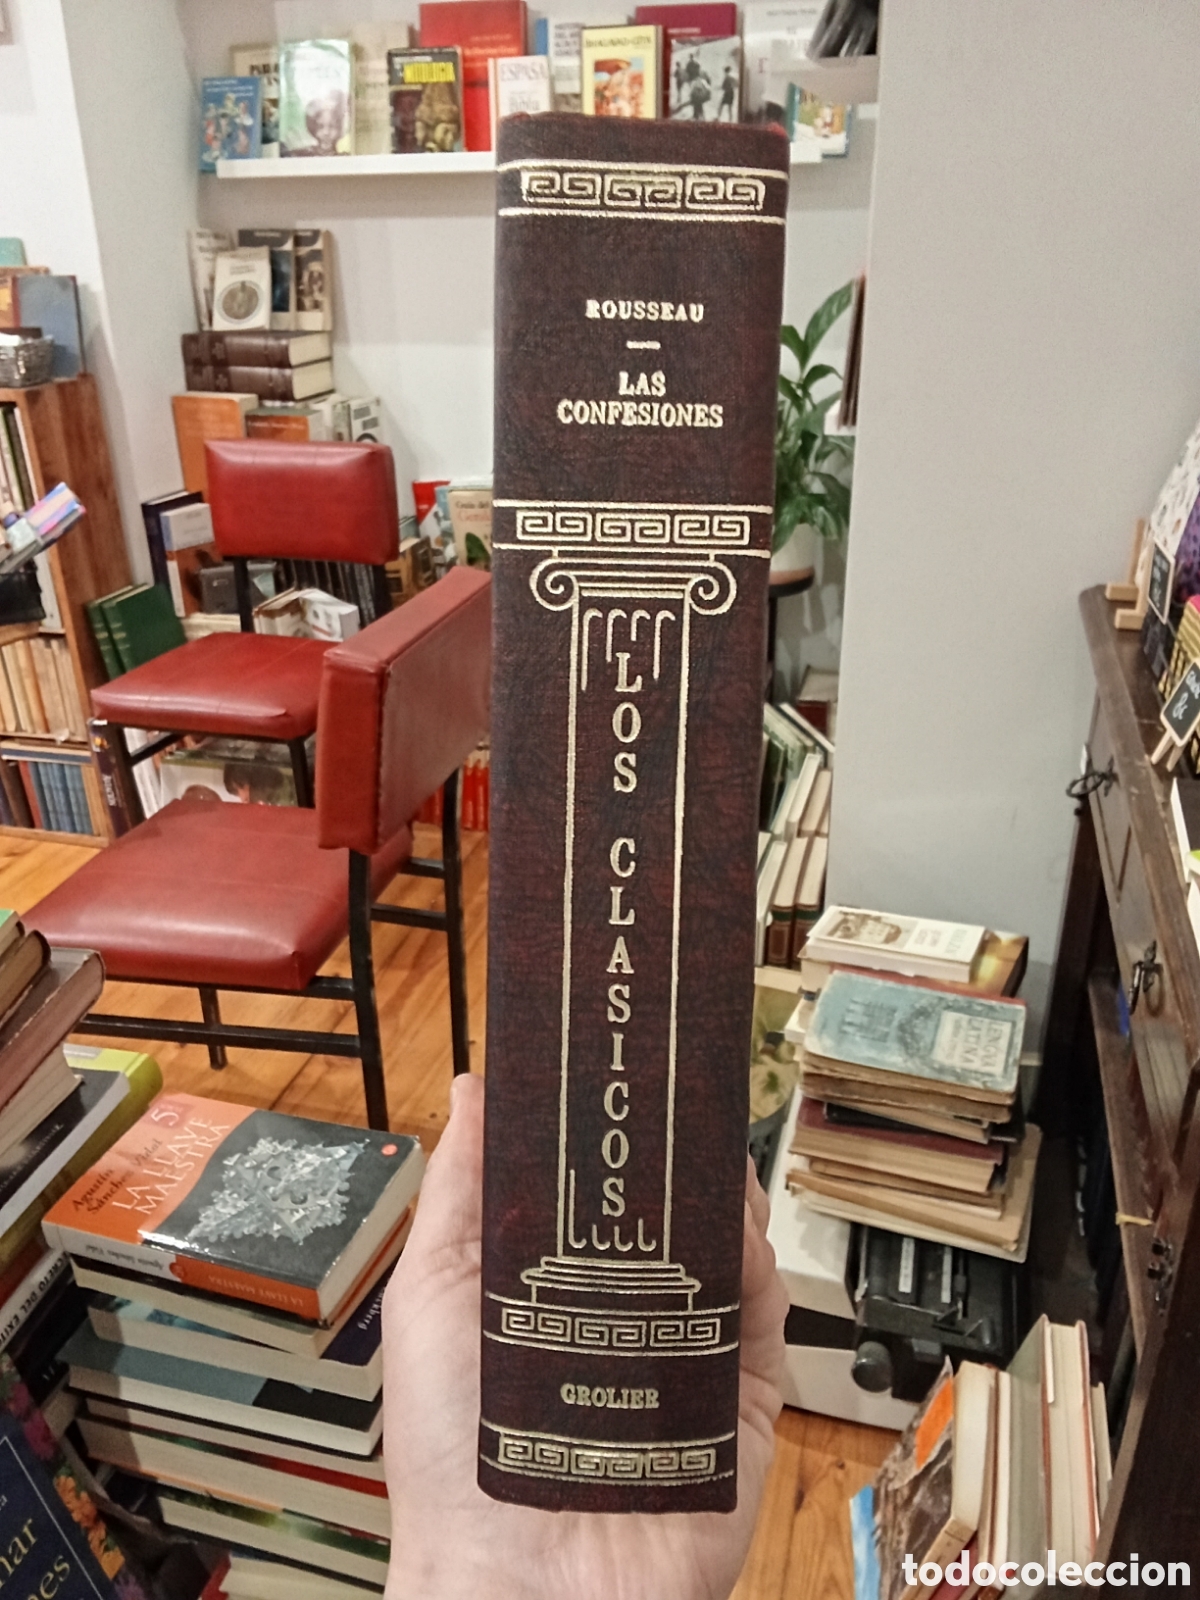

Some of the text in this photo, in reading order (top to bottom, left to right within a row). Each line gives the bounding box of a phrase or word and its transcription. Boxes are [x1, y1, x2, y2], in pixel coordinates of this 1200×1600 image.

[586, 299, 705, 323] ROUSSEAU
[618, 371, 667, 397] LAS
[556, 398, 724, 428] CONFESIONES
[601, 652, 643, 1218] LOS CLASICOS
[111, 1116, 213, 1210] LA LLAVE
[134, 1122, 231, 1215] MAESTRA
[20, 1291, 38, 1314] DEL
[0, 1314, 20, 1345] EXIT
[560, 1383, 660, 1410] GROLIER
